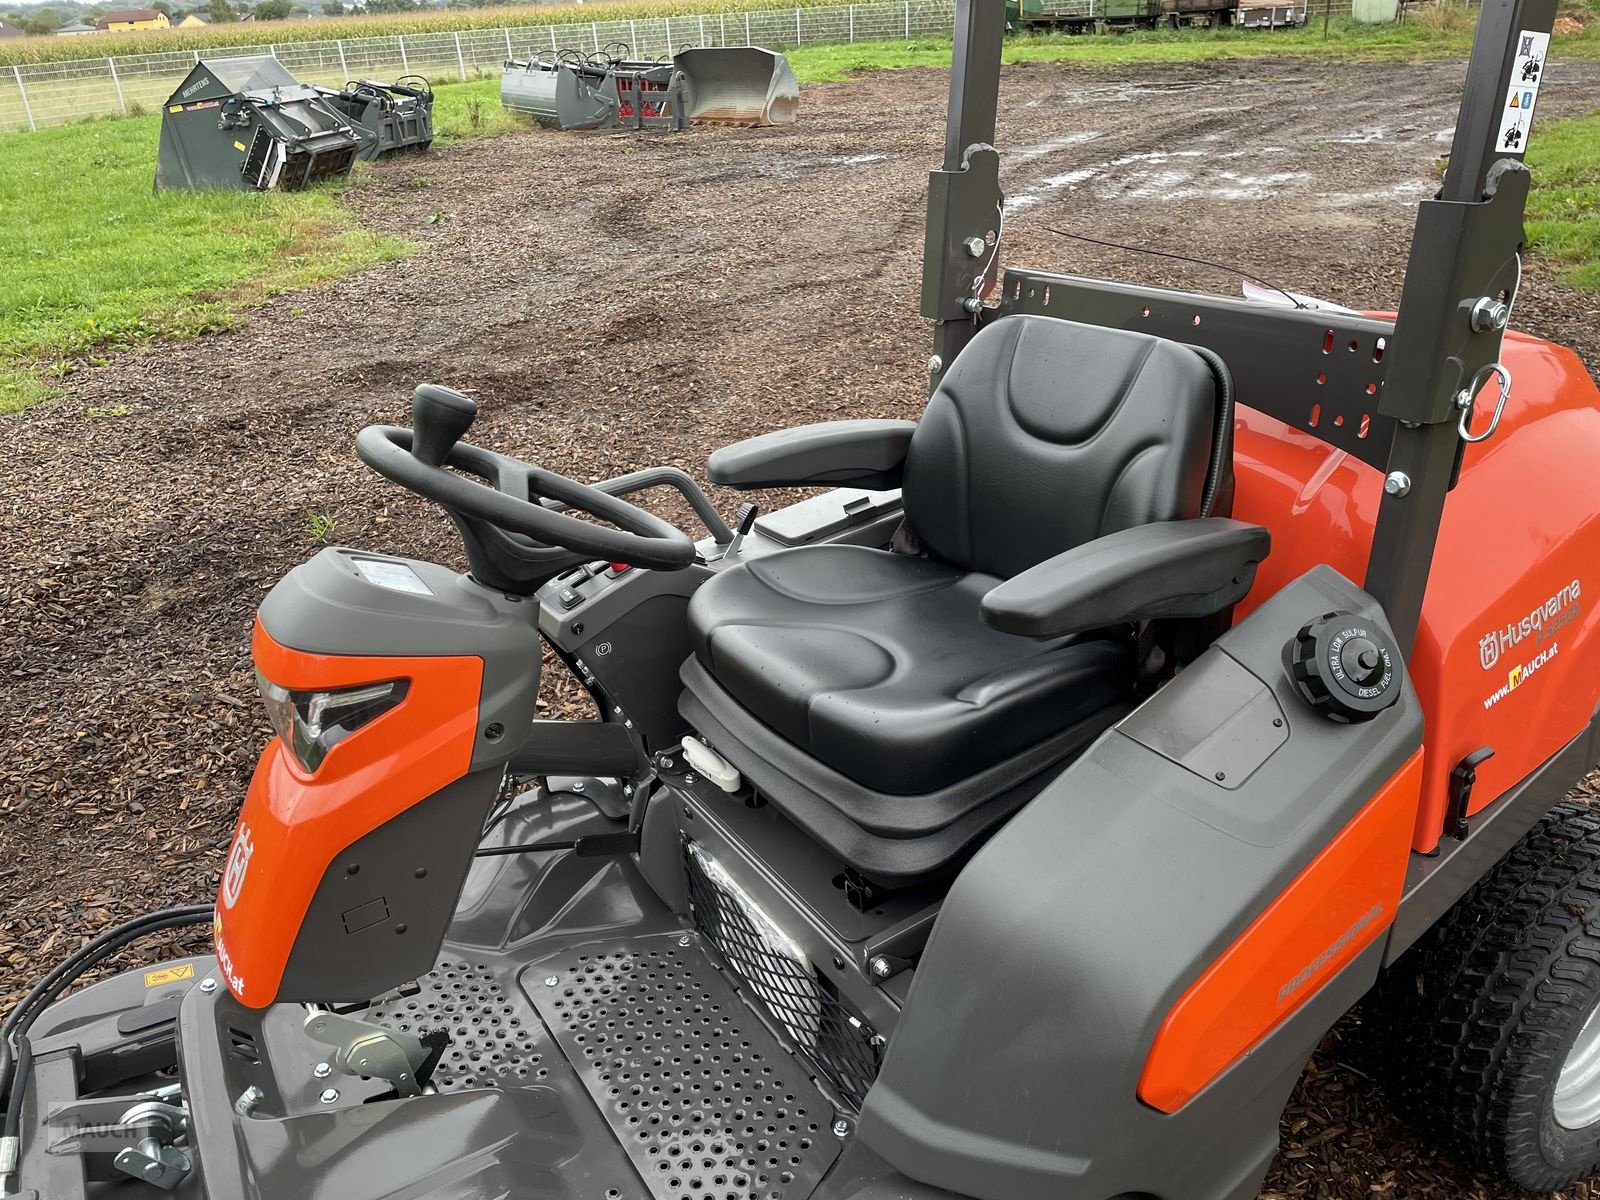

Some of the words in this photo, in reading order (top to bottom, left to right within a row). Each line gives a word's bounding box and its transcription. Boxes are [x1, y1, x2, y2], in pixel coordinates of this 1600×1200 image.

[1499, 579, 1581, 654] Husqvarna
[1342, 628, 1367, 639] SULFUR
[1332, 637, 1344, 652] LOW
[1380, 648, 1391, 667] ONLY
[1331, 656, 1345, 680] ULTRA
[1483, 641, 1559, 710] www.MAUCH.at
[1381, 672, 1392, 689] FUEL
[1359, 687, 1381, 697] DIESEL
[1277, 900, 1382, 1003] PROFESSIONAL
